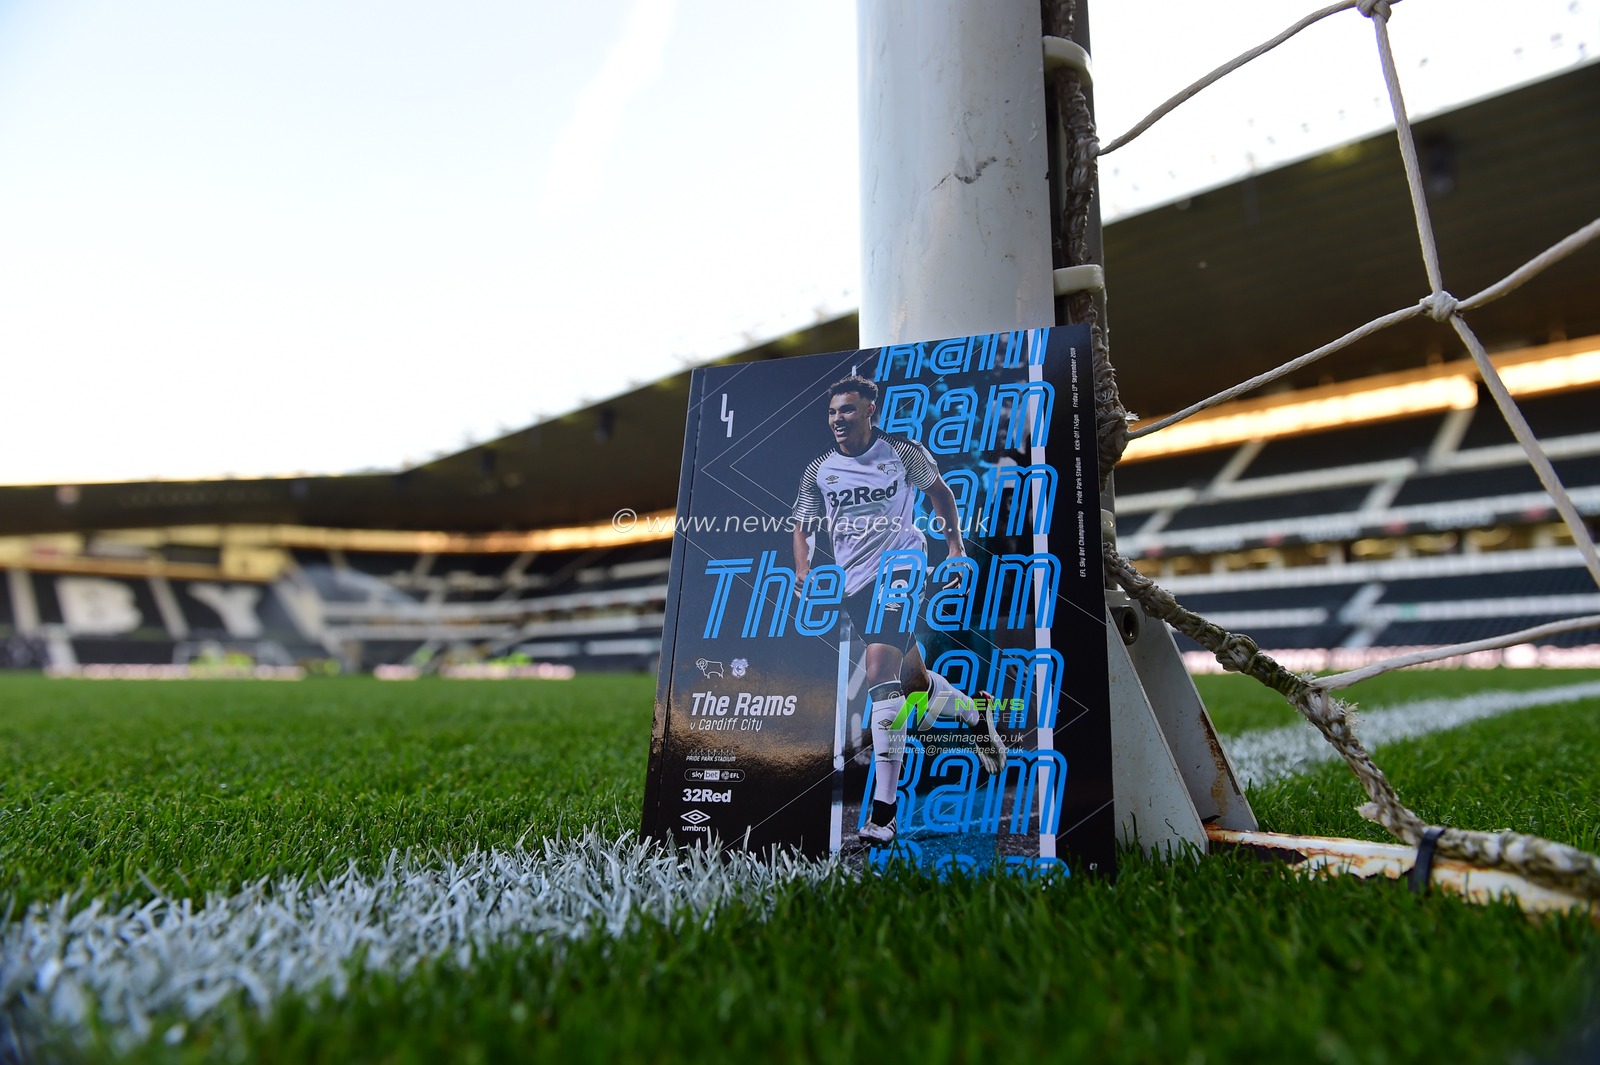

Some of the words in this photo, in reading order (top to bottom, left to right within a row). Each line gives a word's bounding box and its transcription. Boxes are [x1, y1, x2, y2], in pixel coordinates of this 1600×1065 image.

[1070, 359, 1078, 383] September
[826, 480, 898, 508] 32Red
[1077, 510, 1085, 546] Championship
[703, 550, 847, 639] The
[865, 550, 1062, 635] Ram
[691, 691, 730, 716] The
[734, 692, 797, 716] Rams
[698, 717, 739, 731] Cardiff
[740, 717, 763, 733] City
[691, 771, 704, 779] sky
[705, 771, 718, 779] bet
[682, 788, 732, 803] 32Red
